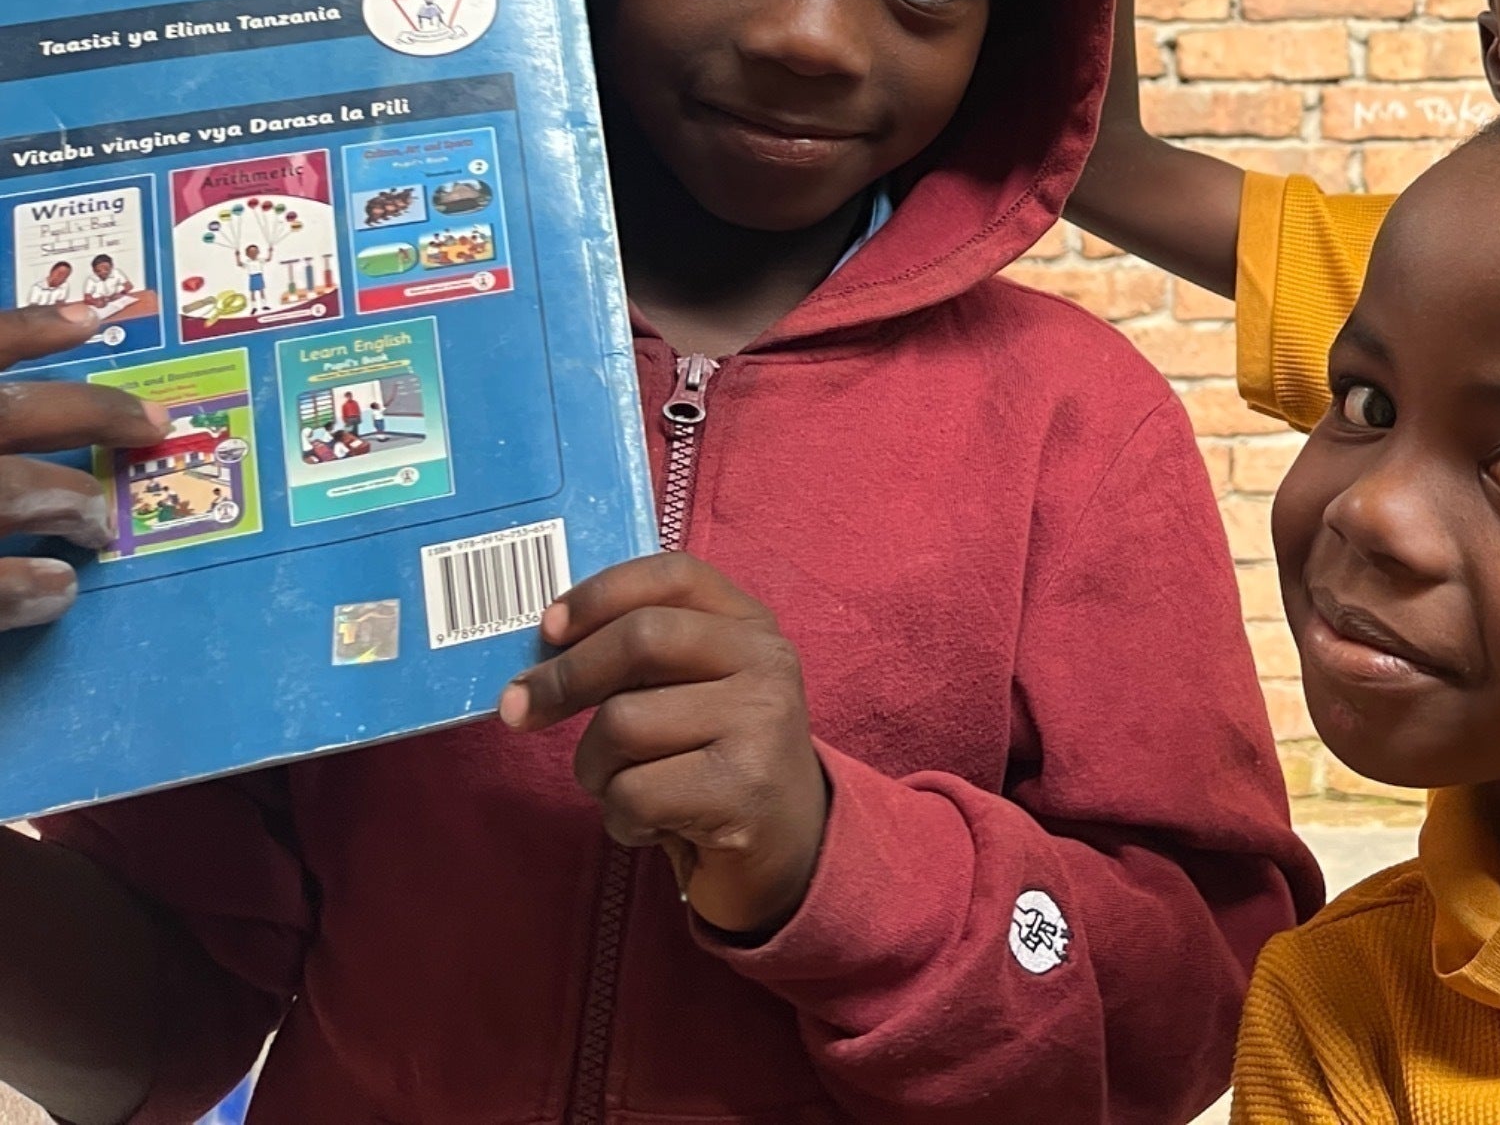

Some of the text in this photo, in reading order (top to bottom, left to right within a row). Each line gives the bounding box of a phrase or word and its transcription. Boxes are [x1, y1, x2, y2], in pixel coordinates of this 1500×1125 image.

[39, 6, 341, 56] Taasisi ya Elimu Tanzania
[12, 98, 411, 168] Vitabu vingine vya Darasa la Pili
[202, 165, 304, 189] Arithmetic
[31, 197, 125, 221] Writing
[90, 214, 117, 230] Book
[300, 332, 412, 363] Learn English
[323, 353, 389, 373] Pupil's Book
[453, 621, 502, 641] 789912
[508, 614, 541, 628] 7536
